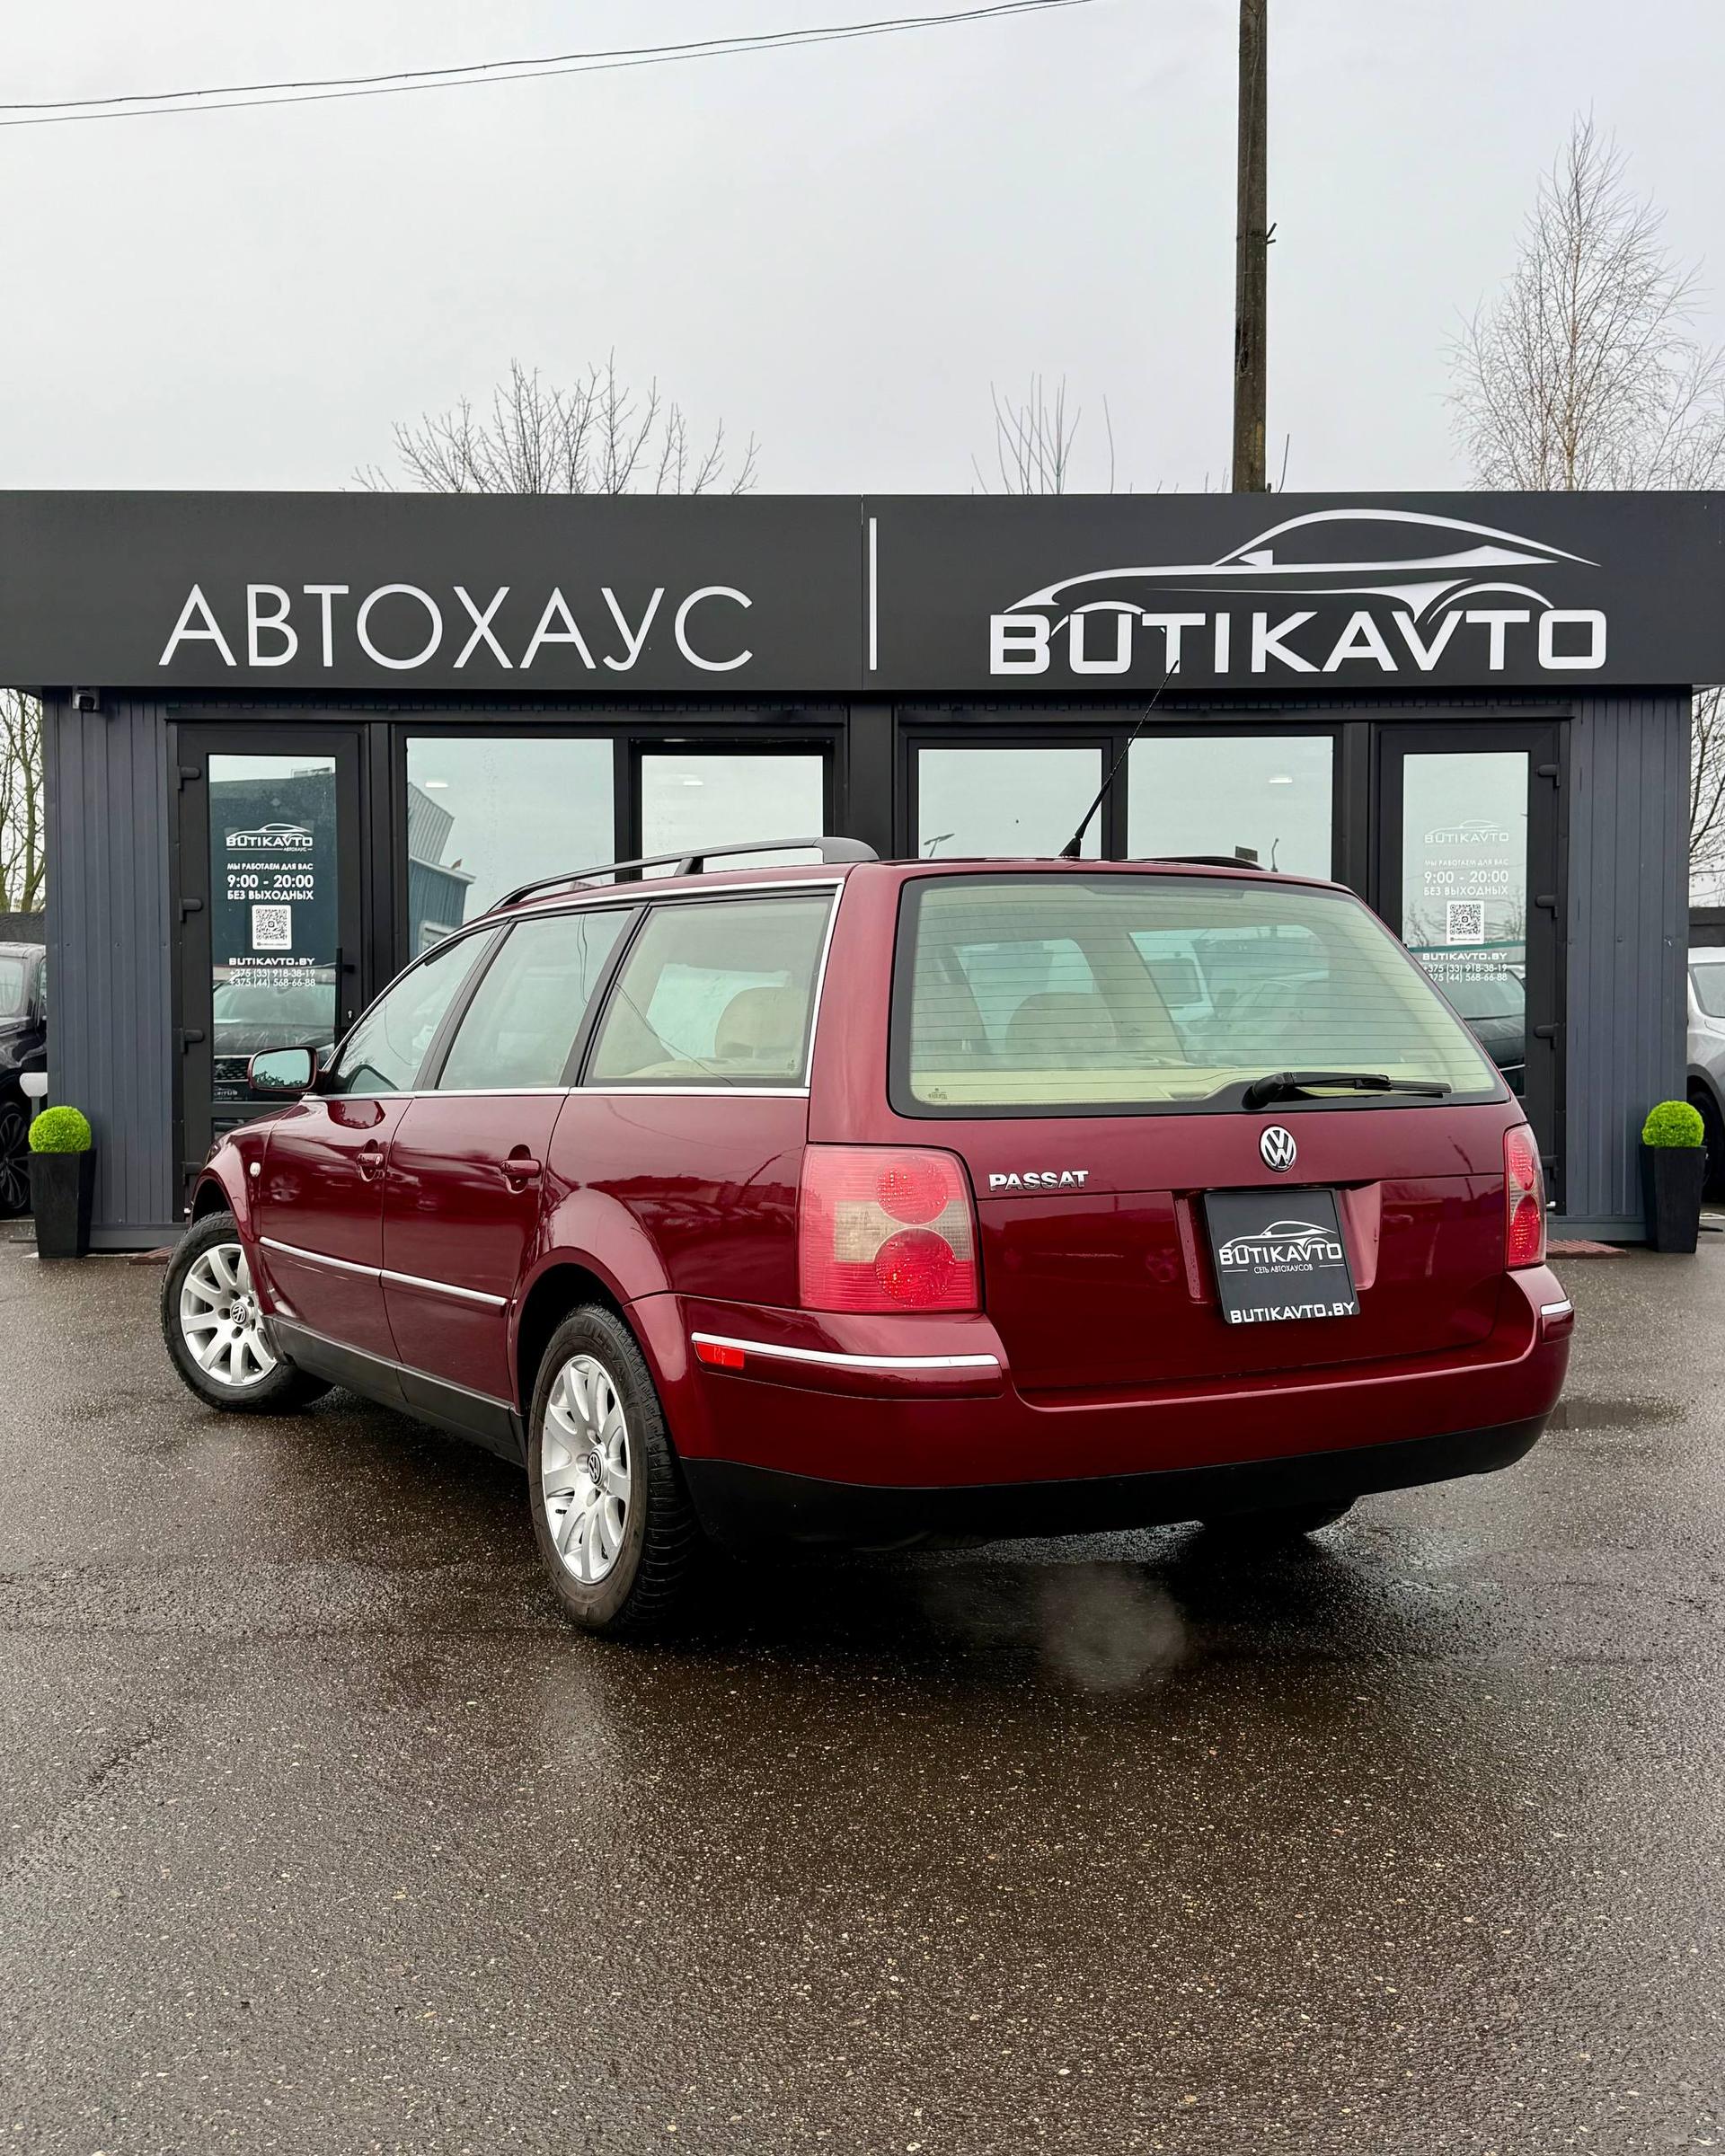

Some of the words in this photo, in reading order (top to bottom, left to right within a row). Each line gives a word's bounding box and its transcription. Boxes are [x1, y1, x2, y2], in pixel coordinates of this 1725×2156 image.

[159, 584, 753, 672] АВТОХАУС
[989, 609, 1607, 675] BUTIKAVTO
[226, 836, 314, 847] BUTIKAVTO
[1424, 833, 1509, 844] BUTIKAVTO
[227, 875, 259, 888] 9:00
[273, 875, 314, 888] 20:00
[1424, 870, 1454, 884] 9:00
[1469, 870, 1509, 883] 20:00
[227, 890, 245, 900] БЕЗ
[248, 890, 314, 901] ВЫХОДНЫХ
[1423, 886, 1441, 896] БЕЗ
[1444, 885, 1508, 897] ВЫХОДНЫХ
[1422, 952, 1508, 960] BUTIKAVTO.BY
[228, 958, 315, 966] BUTIKAVTO.BY
[230, 969, 252, 977] +375
[253, 969, 270, 978] (33)
[1446, 964, 1463, 973] (33)
[253, 978, 270, 987] (44)
[1446, 973, 1463, 983] (44)
[988, 1170, 1089, 1191] PASSAT
[1218, 1243, 1342, 1265] BUTIKAVTO
[1253, 1266, 1269, 1274] СЕТЬ
[1270, 1263, 1313, 1274] АВТОХАУСОВ
[1230, 1302, 1355, 1324] BUTIKAVTO.BY
